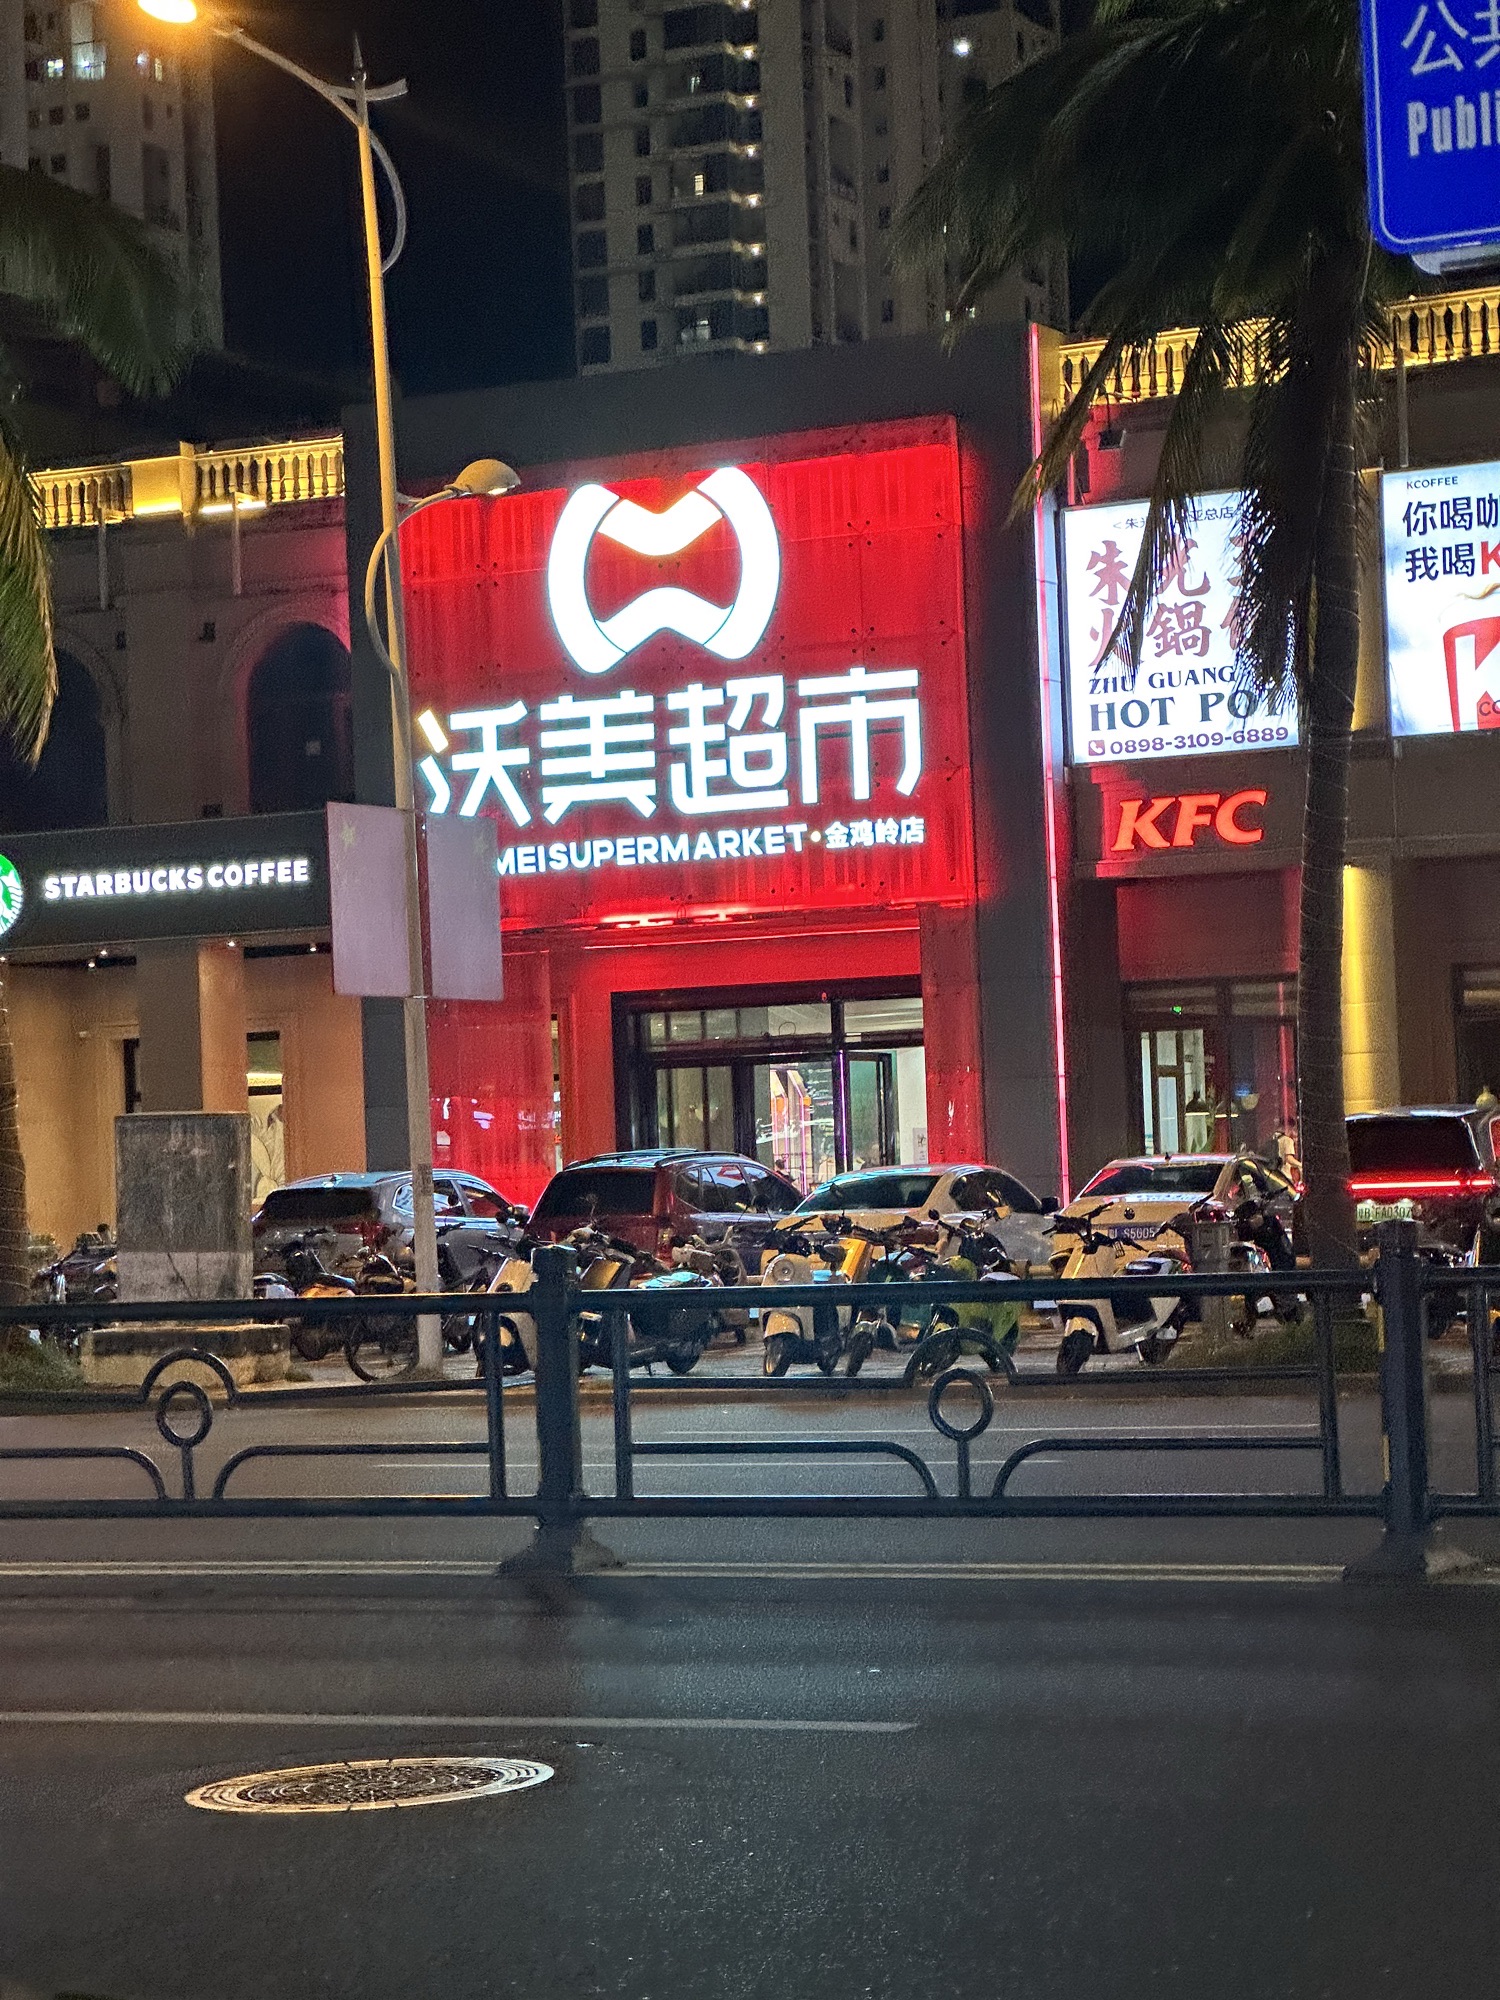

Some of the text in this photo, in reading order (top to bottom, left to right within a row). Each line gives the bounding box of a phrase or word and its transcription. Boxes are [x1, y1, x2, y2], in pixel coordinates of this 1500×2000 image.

[1406, 476, 1458, 490] KCOFFEE
[1148, 665, 1236, 689] GUANG
[1090, 696, 1176, 732] HOT
[417, 667, 920, 828] 沃美超市
[1110, 726, 1289, 755] 0898-3109-6889
[1110, 789, 1267, 852] KFC
[44, 858, 310, 901] STARBUCKS COFFEE
